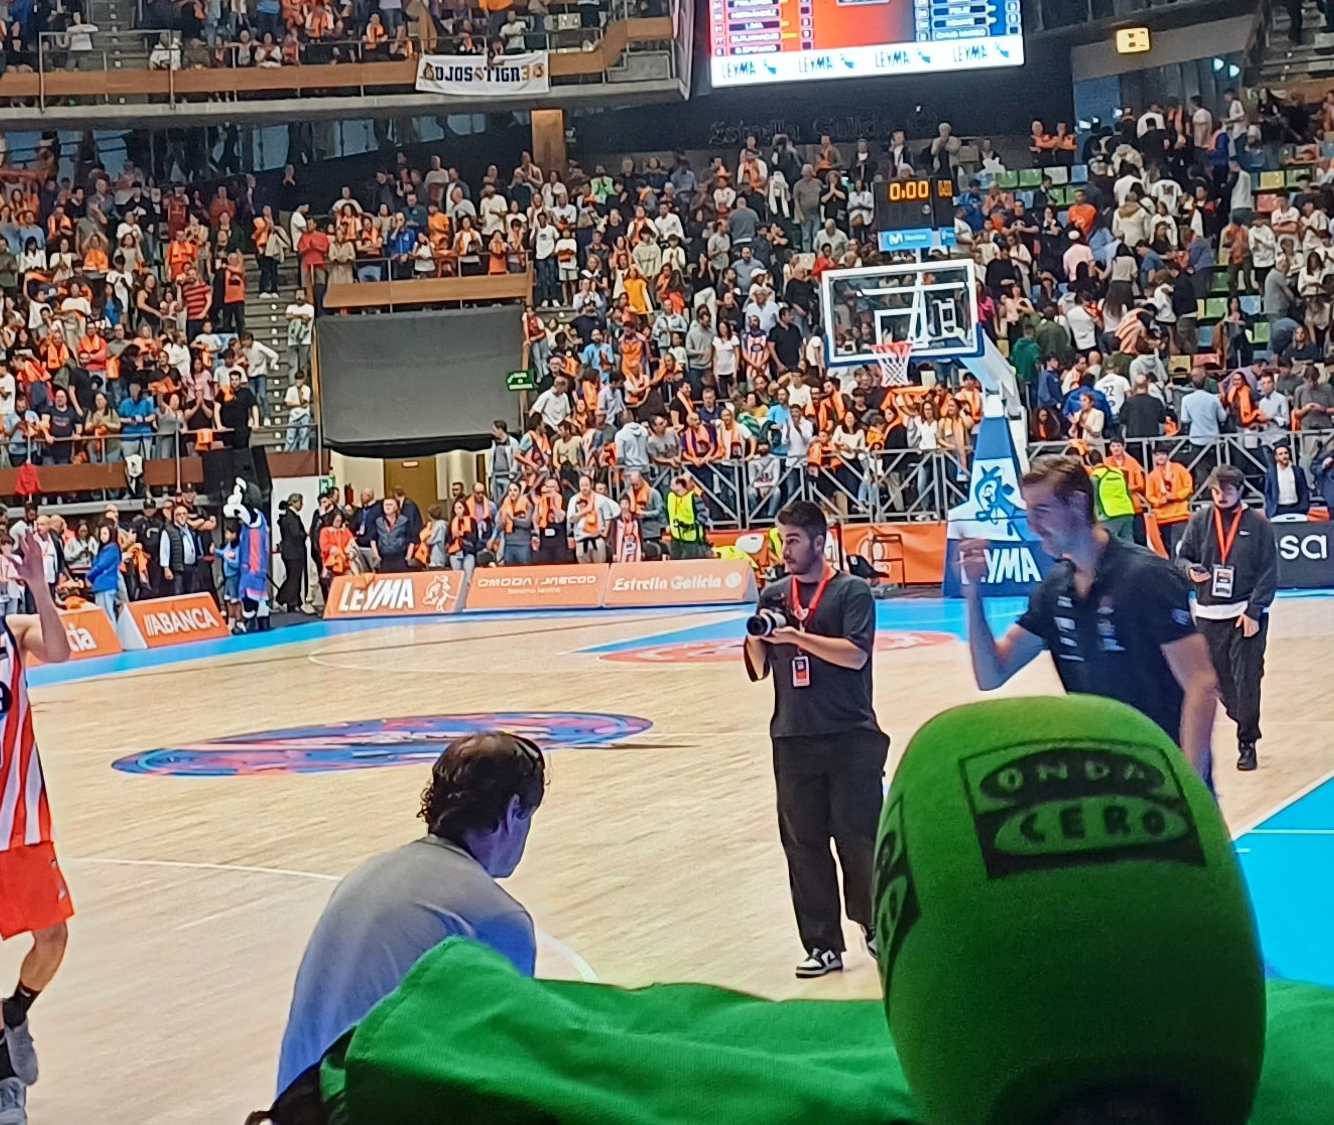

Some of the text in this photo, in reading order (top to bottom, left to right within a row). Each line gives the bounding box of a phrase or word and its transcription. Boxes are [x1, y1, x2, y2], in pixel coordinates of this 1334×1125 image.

[722, 45, 987, 78] LEYMA LEYMA LEYMA LEYMA
[477, 576, 532, 588] OMODA
[971, 547, 1042, 585] YMA
[338, 578, 415, 612] LEYMA
[612, 575, 721, 592] Estrella Galicia
[151, 607, 220, 636] ABANCA
[997, 760, 1145, 792] ONDA
[1019, 805, 1167, 843] CERO
